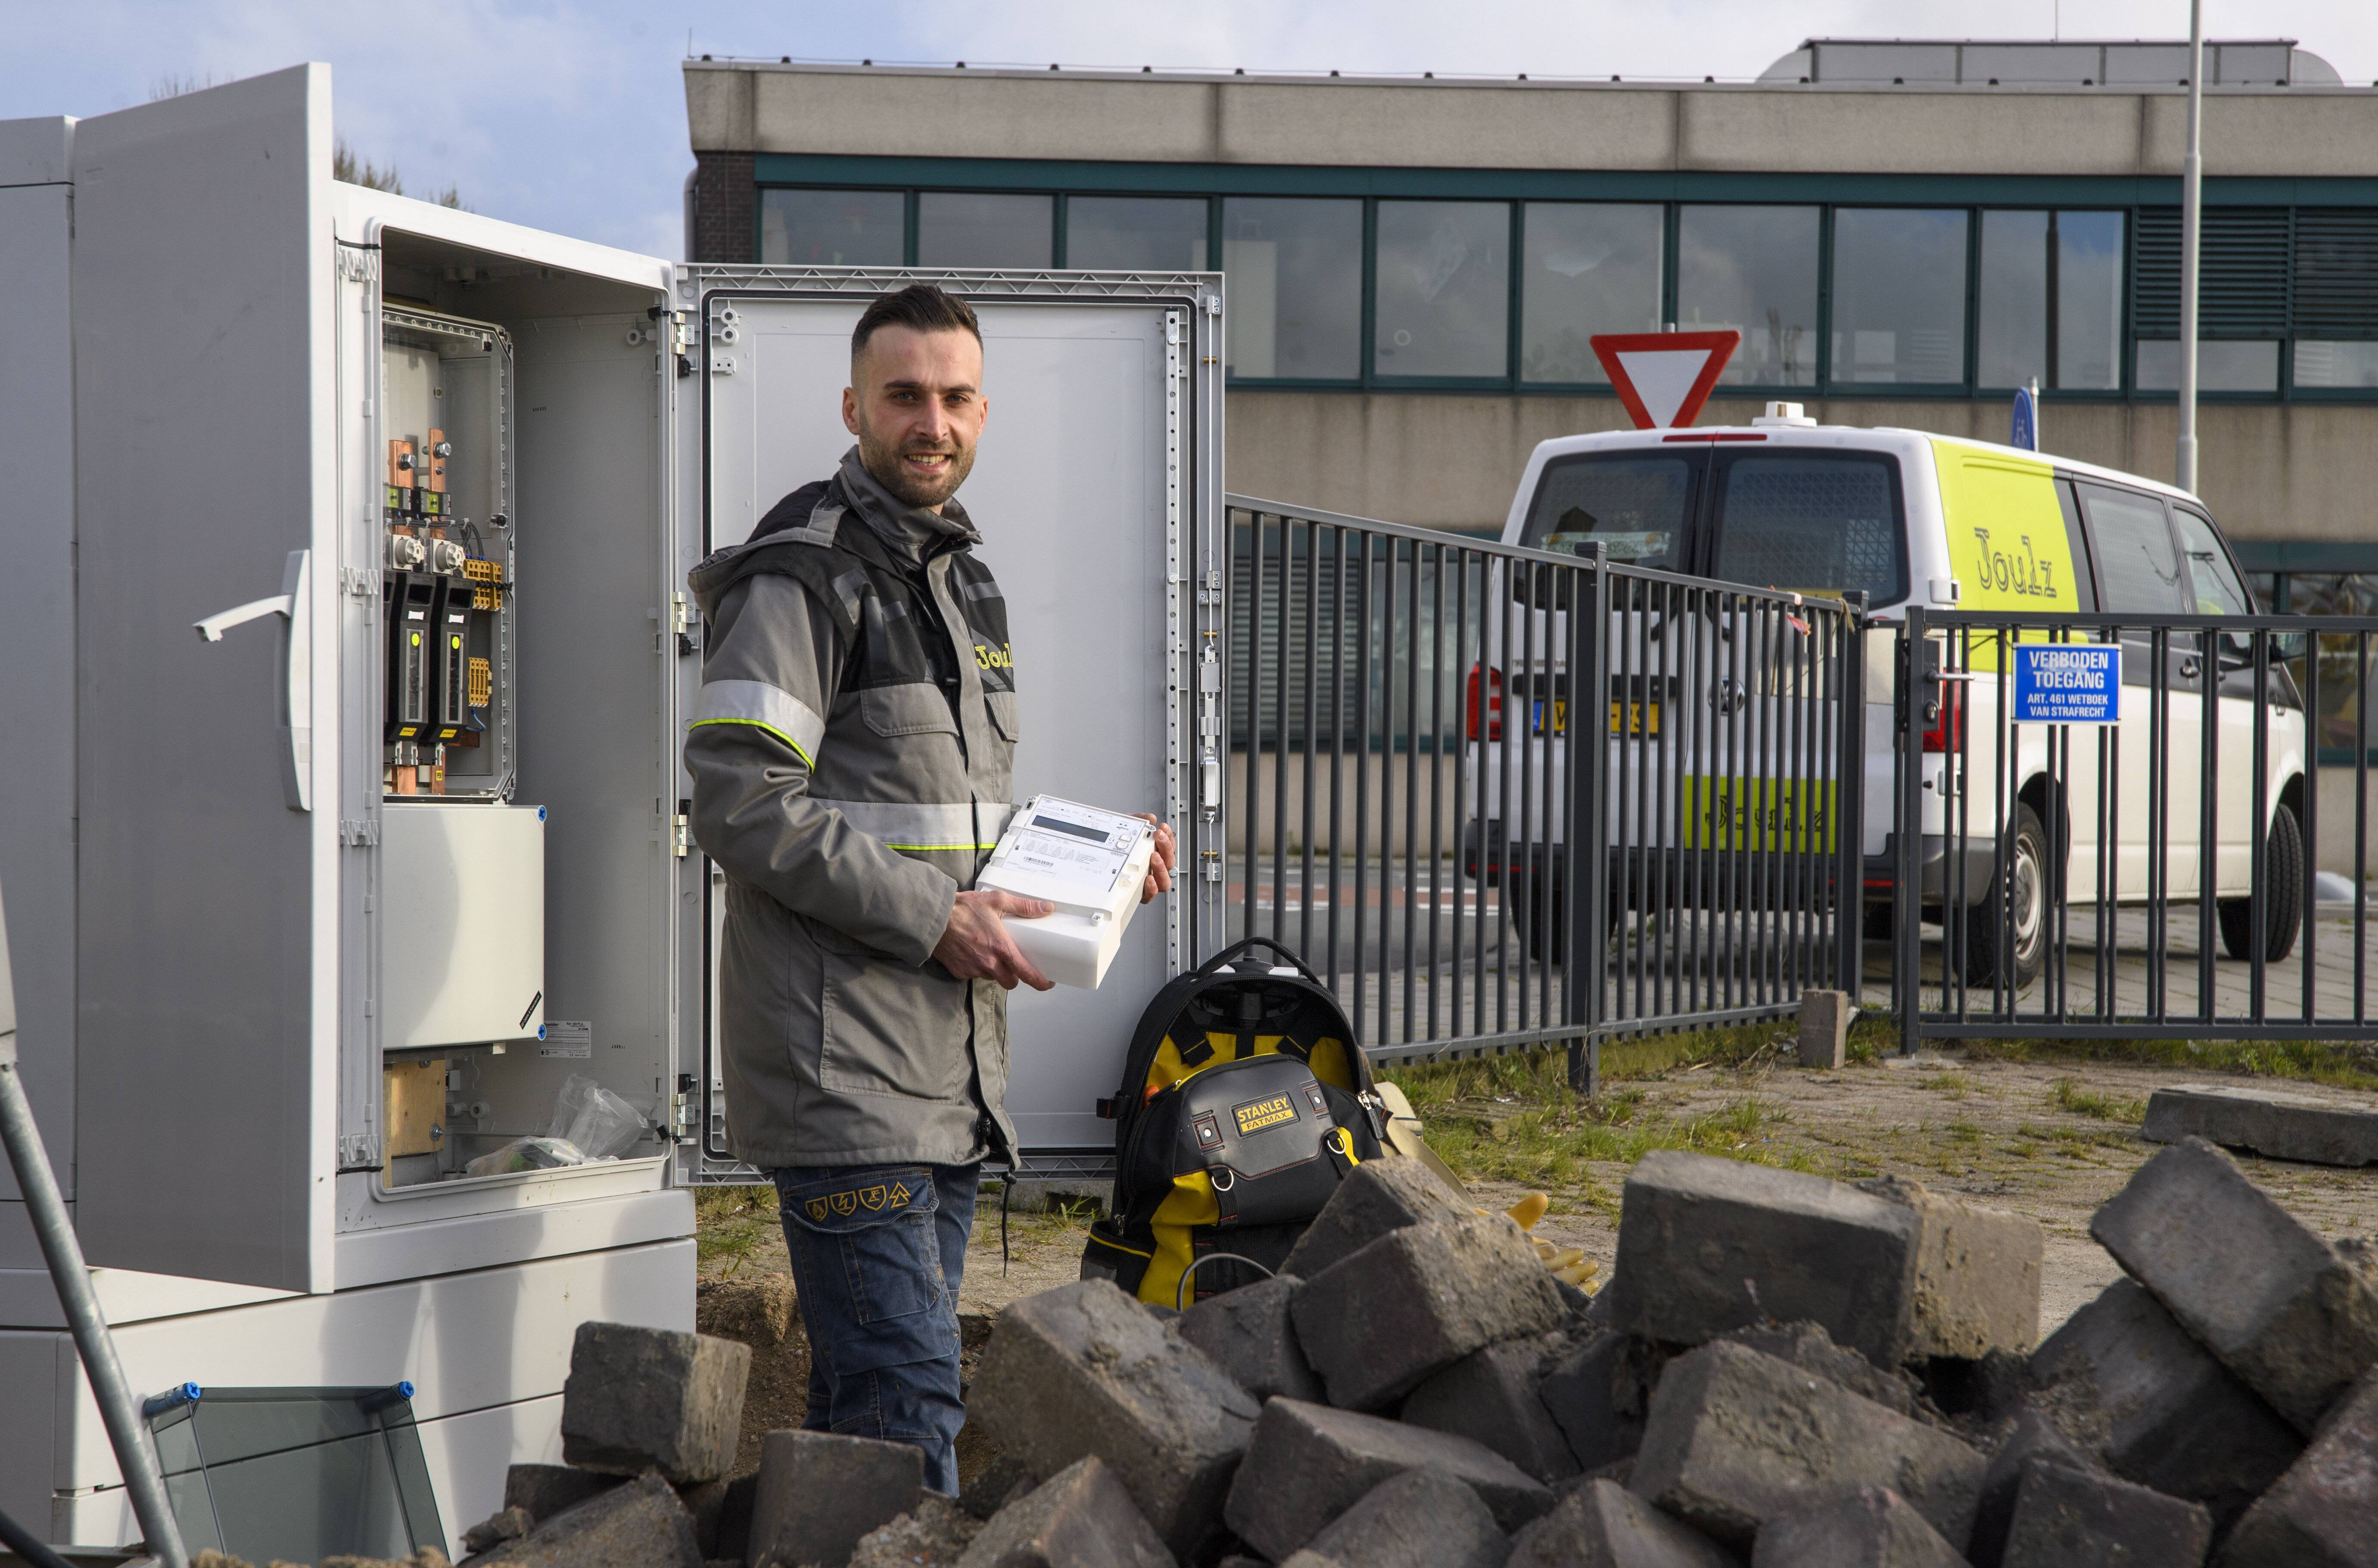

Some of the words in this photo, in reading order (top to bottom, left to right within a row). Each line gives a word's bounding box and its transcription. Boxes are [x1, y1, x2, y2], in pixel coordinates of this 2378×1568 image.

[1974, 527, 2057, 598] Joulz
[2029, 651, 2108, 669] VERBODEN
[2033, 671, 2104, 688] TOEGANG
[2027, 694, 2047, 704] ART.
[2050, 694, 2065, 704] 461
[2068, 694, 2108, 705] WETBOEK
[2030, 706, 2049, 716] VAN
[2051, 706, 2105, 717] STRAFRECHT
[1237, 1098, 1287, 1122] STANLEY
[1247, 1112, 1287, 1129] FATMAX
